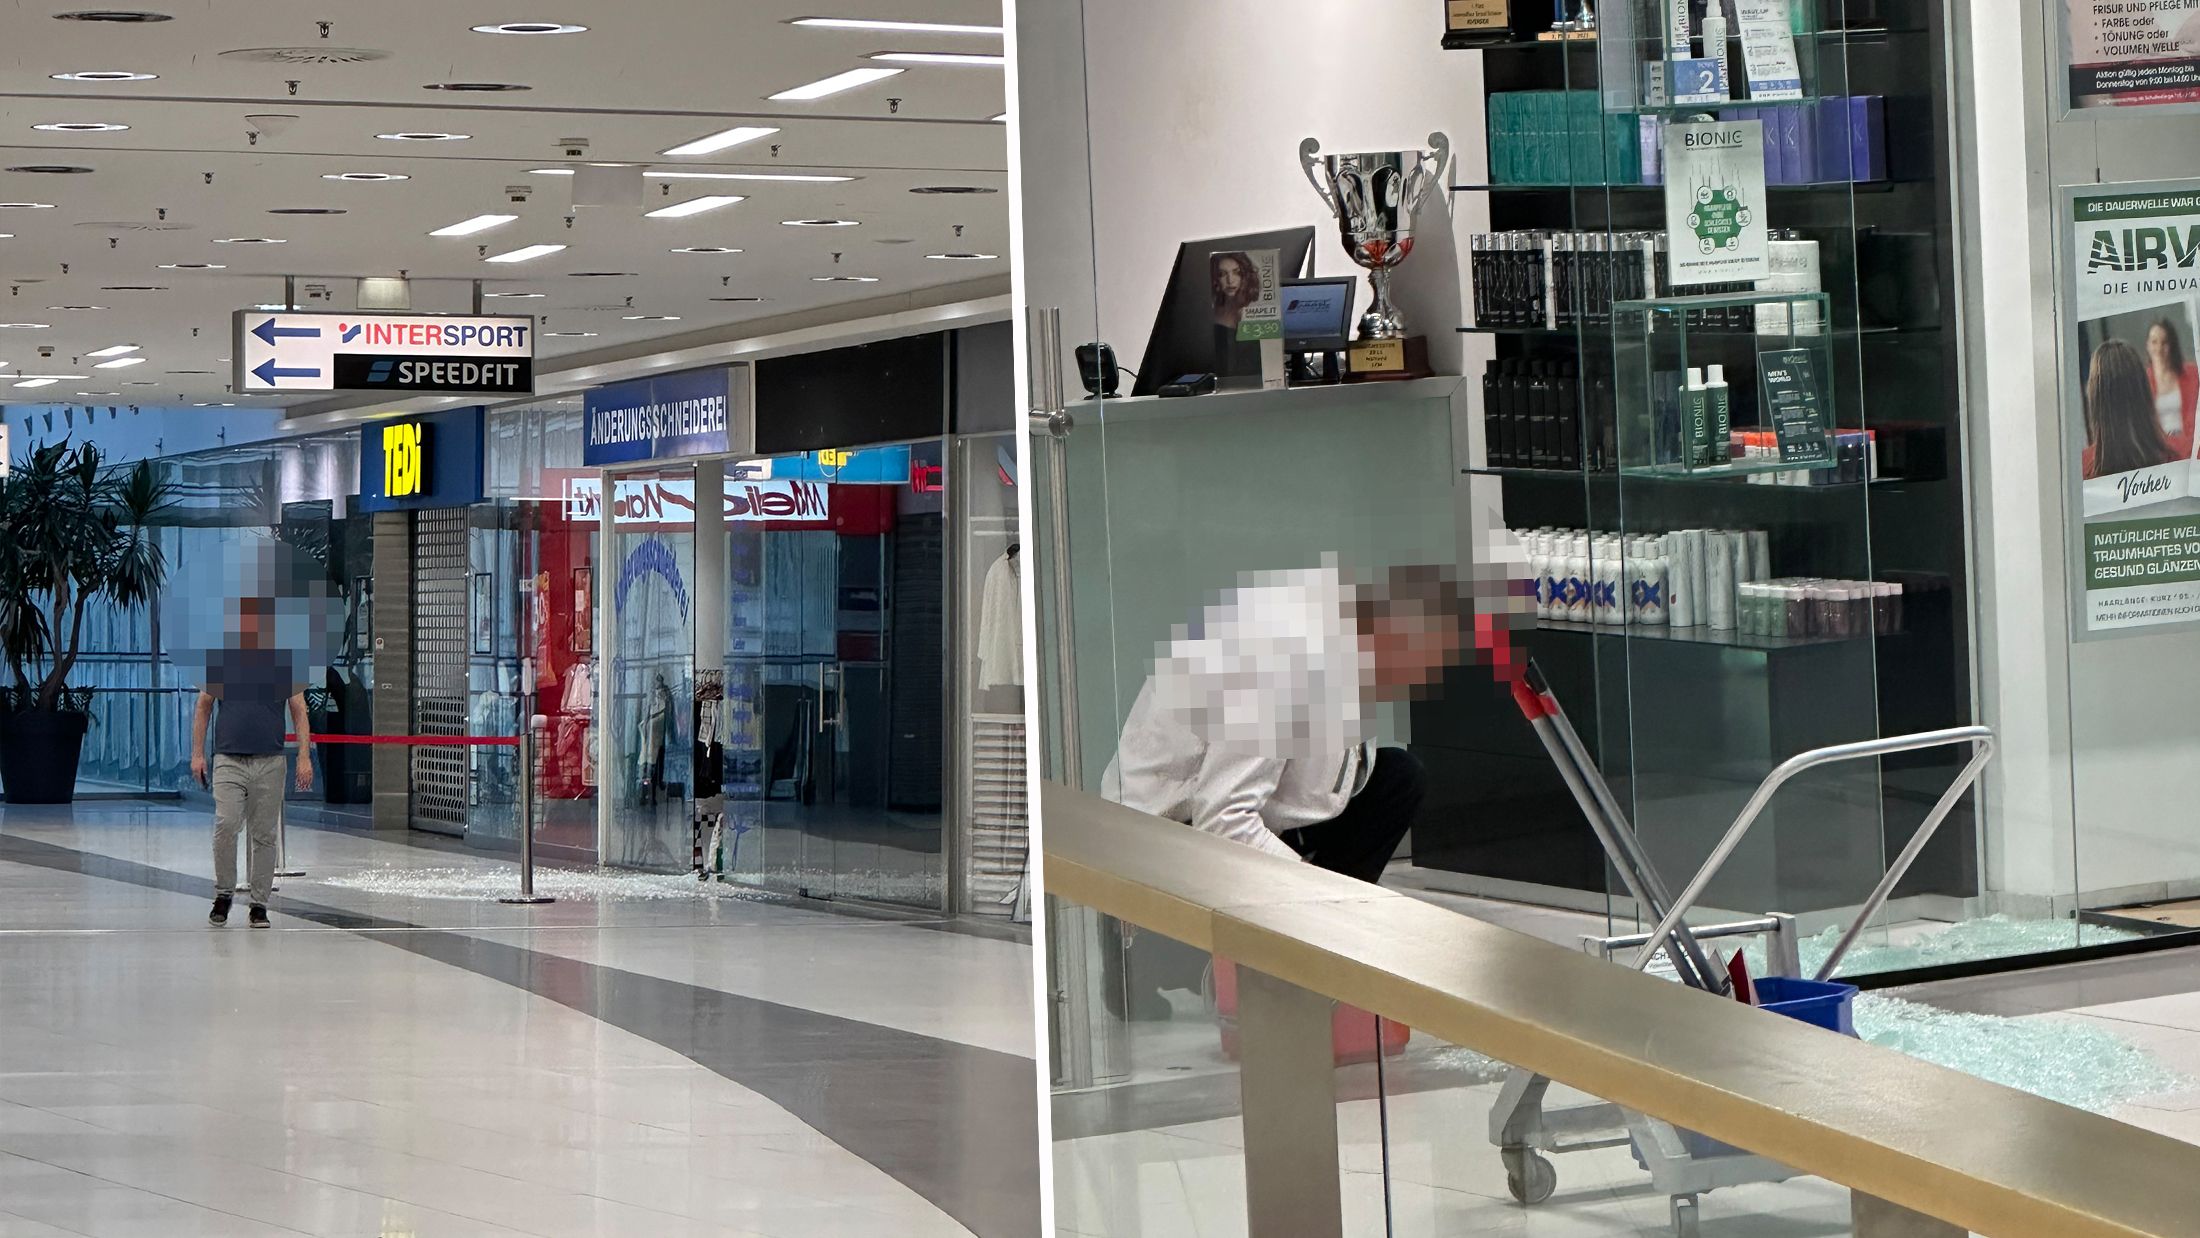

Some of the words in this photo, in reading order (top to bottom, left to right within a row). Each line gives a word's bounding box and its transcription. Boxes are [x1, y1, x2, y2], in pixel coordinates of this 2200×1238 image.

[2093, 4, 2124, 15] FRISUR
[2126, 3, 2147, 13] UND
[2149, 1, 2181, 13] PFLEGE
[2102, 17, 2130, 28] FARBE
[2132, 17, 2155, 27] oder
[2102, 30, 2144, 43] TÖNUNG
[2147, 30, 2169, 40] oder
[2103, 44, 2150, 56] VOLUMEN
[2152, 41, 2180, 53] WELLE
[1699, 70, 1715, 93] 2
[2096, 79, 2135, 89] Donnerstag
[2135, 78, 2148, 86] von
[2164, 75, 2173, 84] bis
[1685, 130, 1743, 147] BIONIC
[2088, 202, 2104, 212] DIE
[2105, 198, 2169, 212] DAUERWELLE
[2171, 197, 2194, 208] WAR
[1262, 255, 1273, 301] BIONIC
[2103, 282, 2129, 295] DIE
[2137, 278, 2200, 293] INNOVA
[366, 323, 528, 347] INTERSPORT
[398, 361, 519, 386] SPEEDFIT
[590, 395, 727, 446] ÄNDERUNGSSCHNEIDEREI
[1693, 397, 1704, 438] BIONIC
[1717, 393, 1728, 434] BIONIC
[383, 422, 421, 497] TEDi
[2117, 470, 2171, 503] Vorher
[2094, 527, 2170, 546] NATÜRLICHE
[2093, 544, 2181, 562] TRAUMHAFTES
[2094, 563, 2145, 579] GESUND
